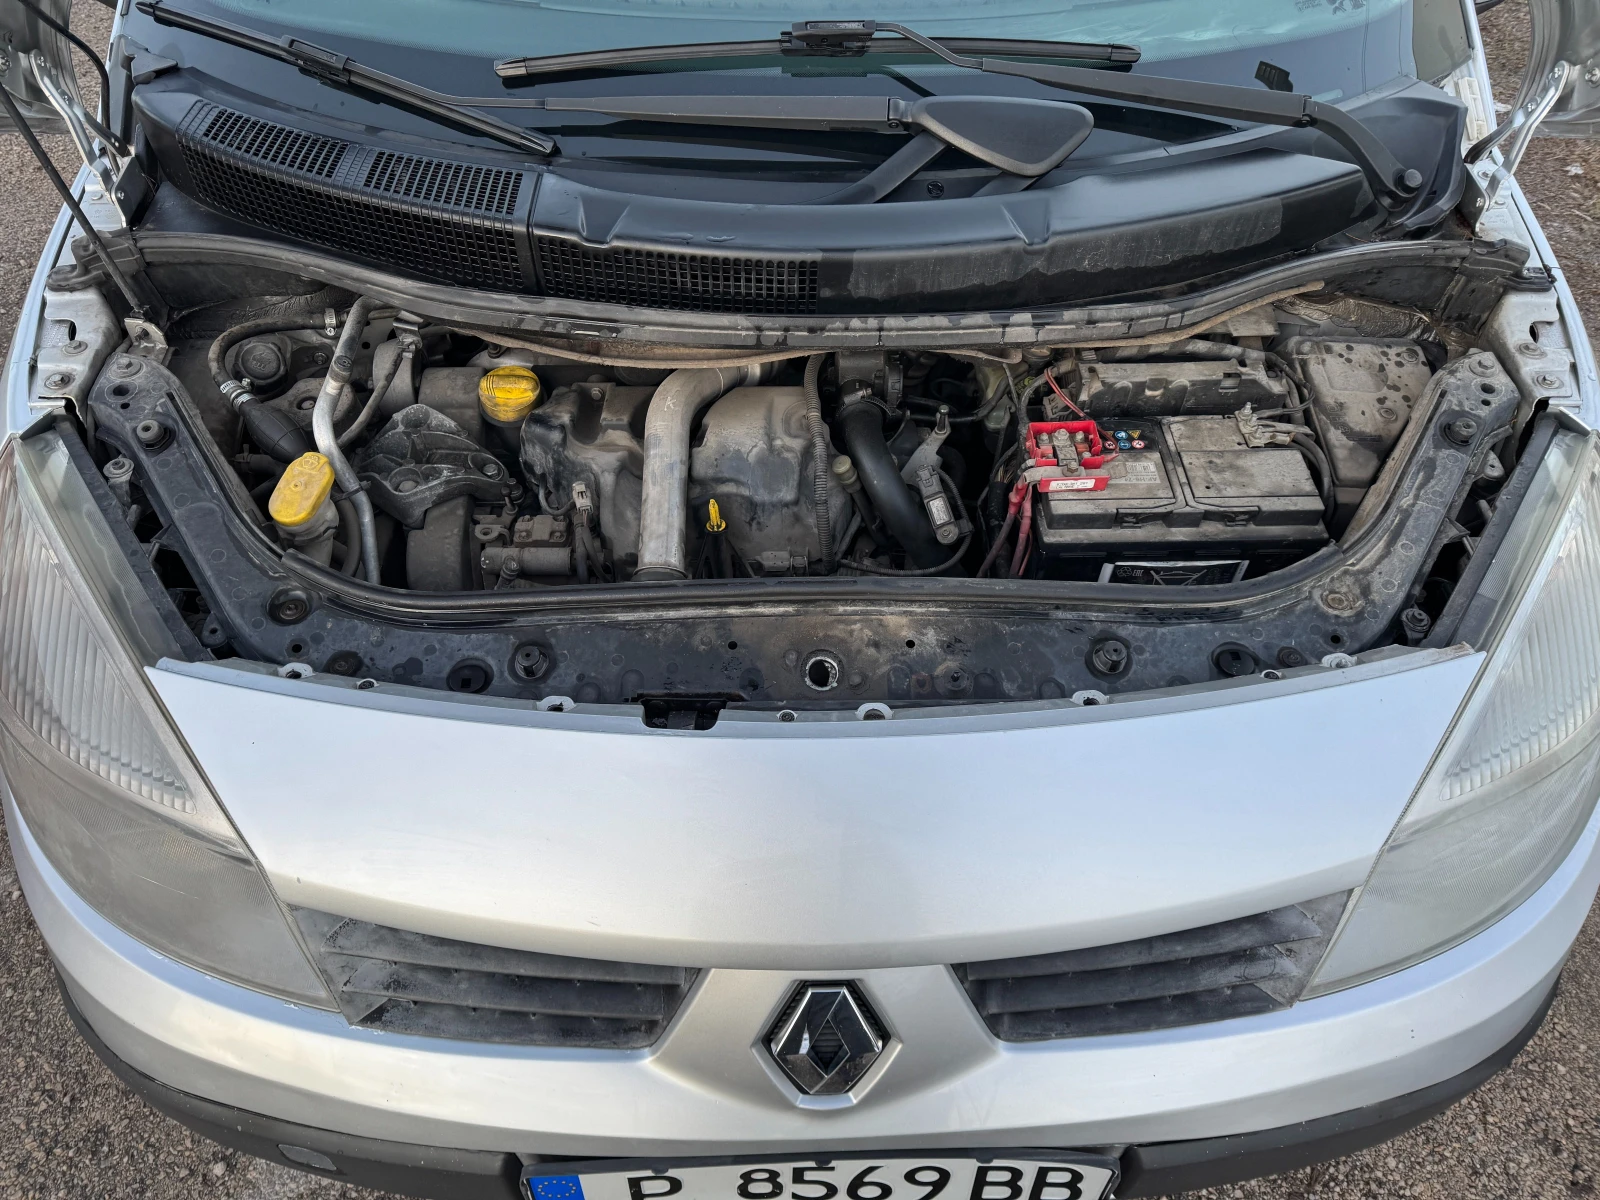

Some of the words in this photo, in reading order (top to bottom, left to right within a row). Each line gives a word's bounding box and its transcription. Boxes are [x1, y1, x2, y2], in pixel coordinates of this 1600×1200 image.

[627, 1175, 683, 1200] P
[736, 1165, 951, 1200] 8569
[969, 1165, 1084, 1200] BB
